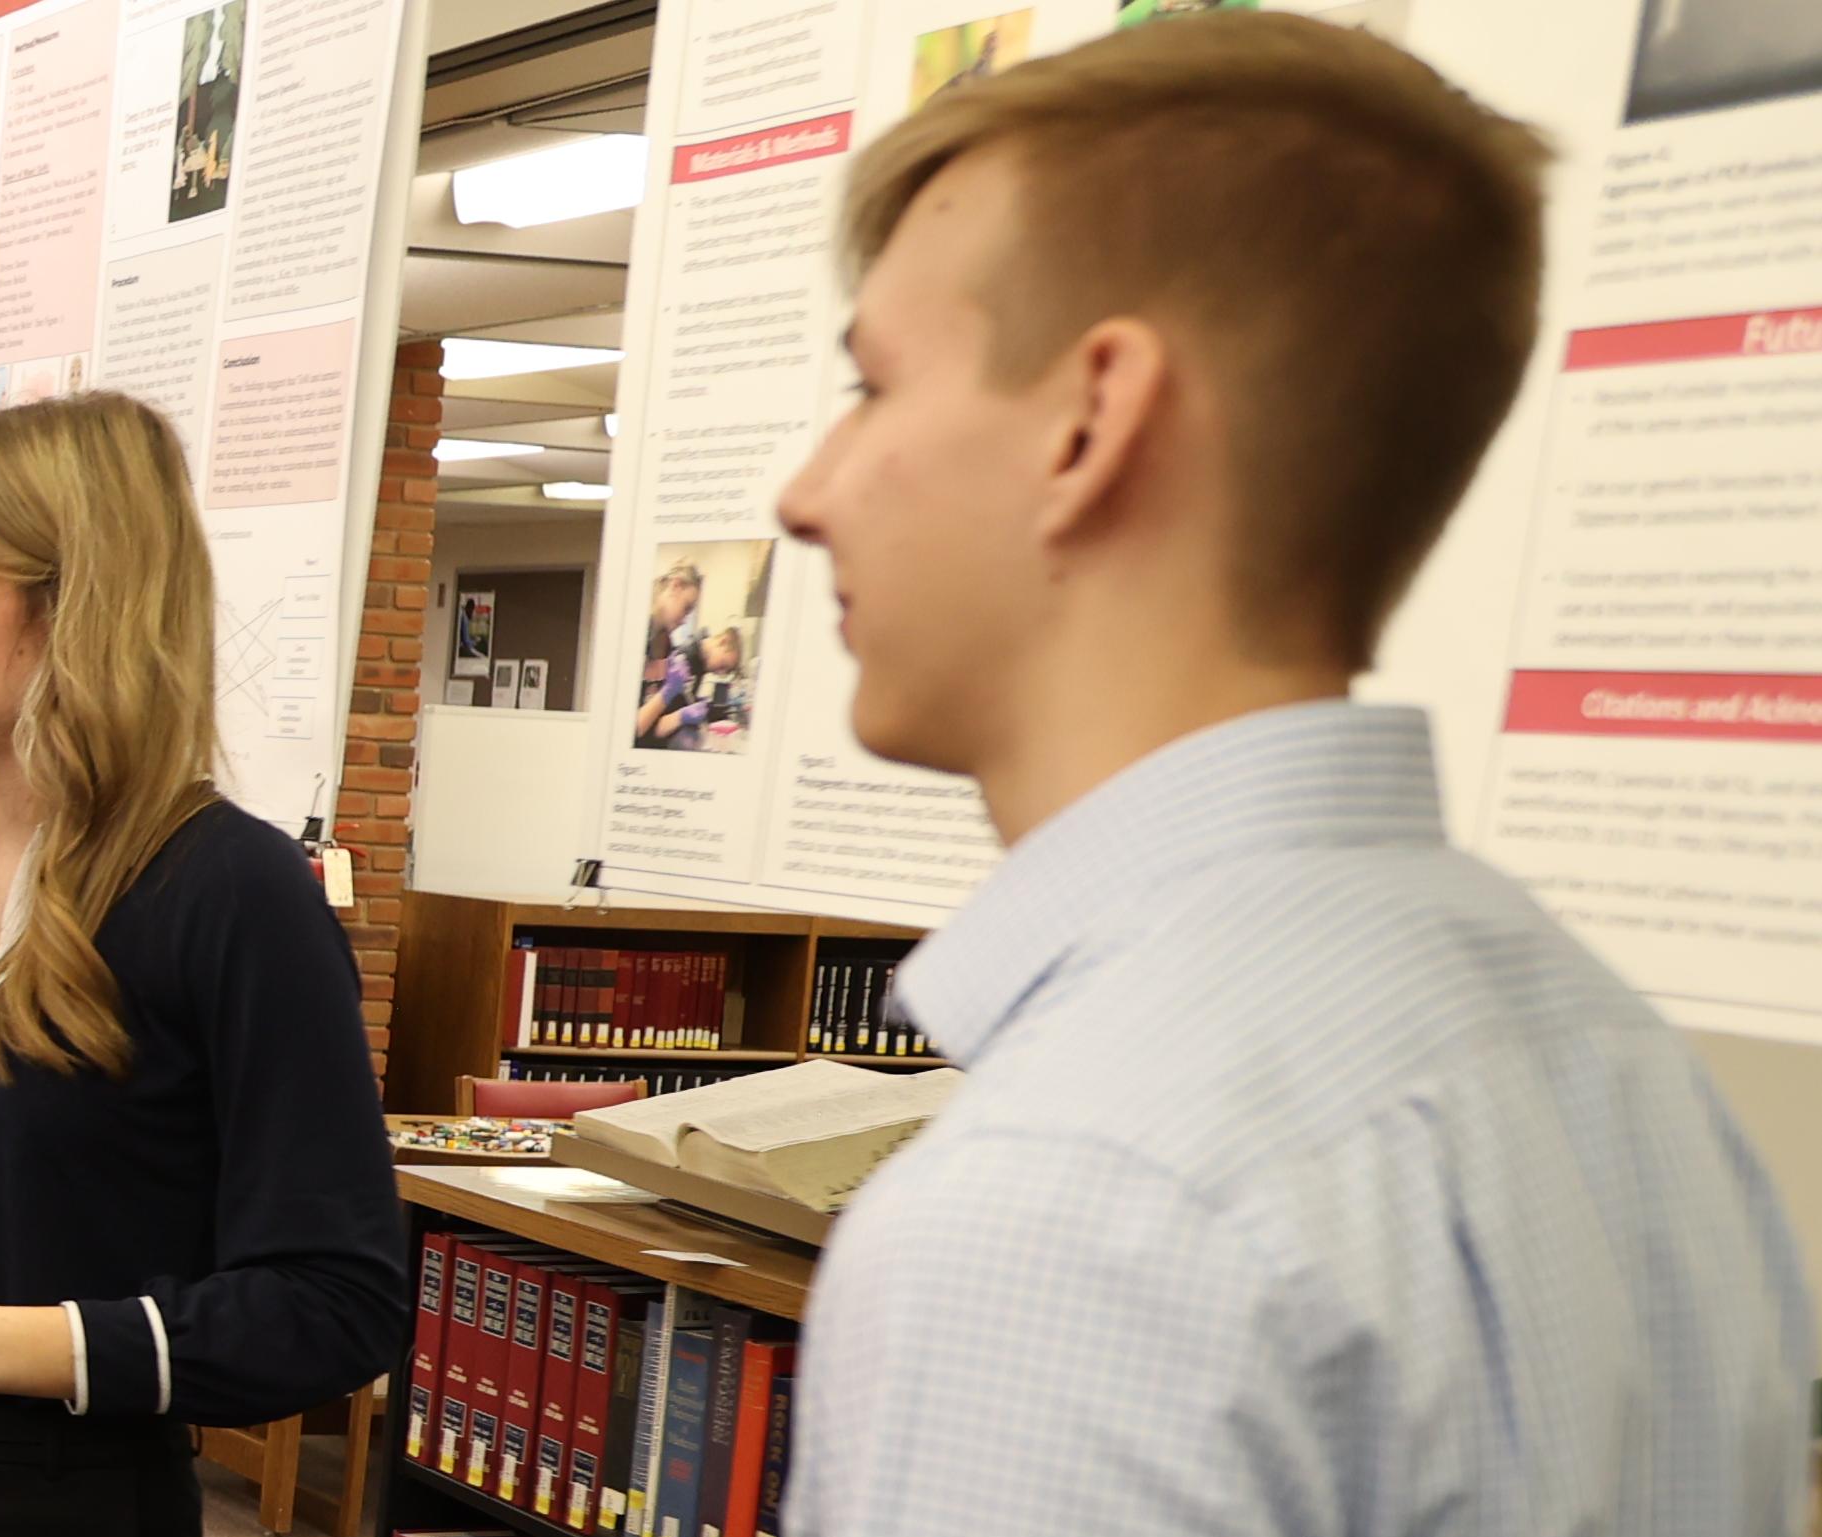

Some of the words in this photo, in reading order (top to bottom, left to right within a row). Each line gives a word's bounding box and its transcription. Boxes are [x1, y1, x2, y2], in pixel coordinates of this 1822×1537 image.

[1580, 688, 1687, 722] Citations
[1690, 693, 1743, 723] and
[768, 1393, 789, 1462] ROCK
[765, 1470, 786, 1507] ON
